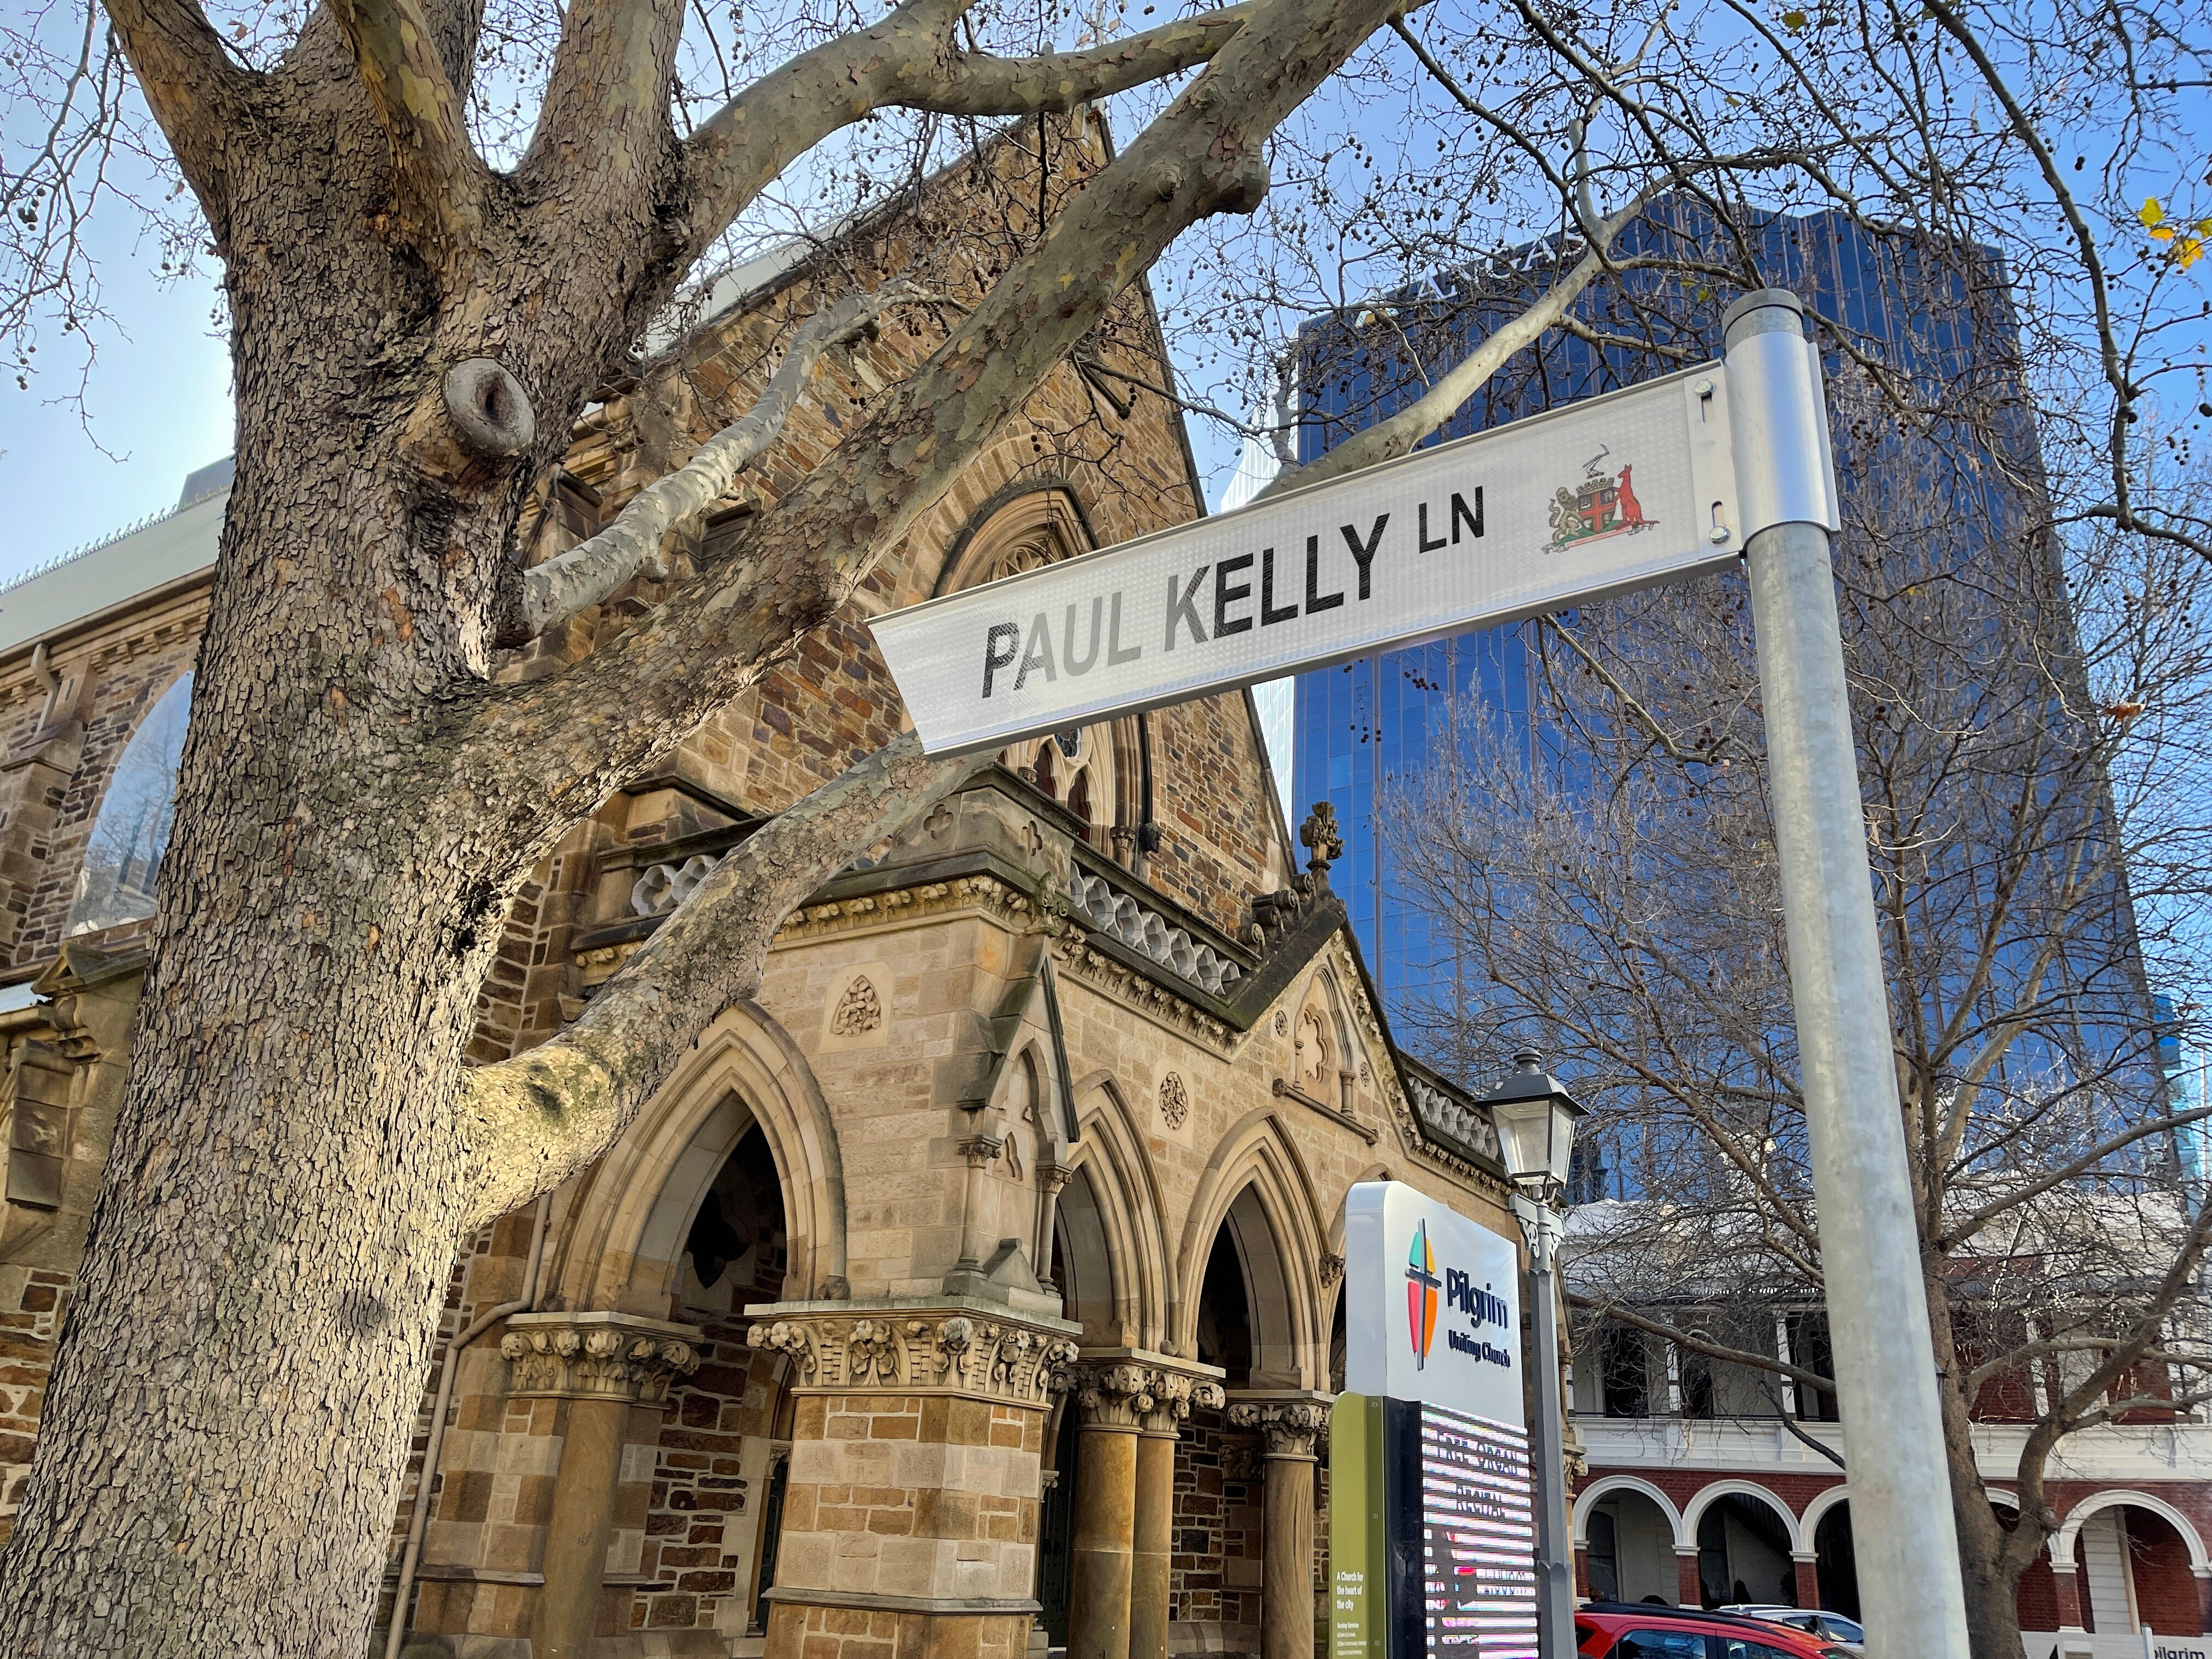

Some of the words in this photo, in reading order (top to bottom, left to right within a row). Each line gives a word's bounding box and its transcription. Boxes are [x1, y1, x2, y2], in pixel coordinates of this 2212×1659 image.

[982, 590, 1142, 698] PAUL
[1164, 513, 1390, 652] KELLY
[1413, 486, 1484, 554] LN
[1447, 1268, 1509, 1330] Pilgrim
[1448, 1329, 1481, 1362] Uniting
[1482, 1342, 1510, 1368] Church
[1336, 1571, 1341, 1581] A
[1341, 1571, 1357, 1581] Church
[1336, 1585, 1345, 1595] the
[1345, 1585, 1357, 1595] heart
[1357, 1585, 1362, 1595] of
[1336, 1599, 1345, 1609] the
[1345, 1599, 1354, 1612] city
